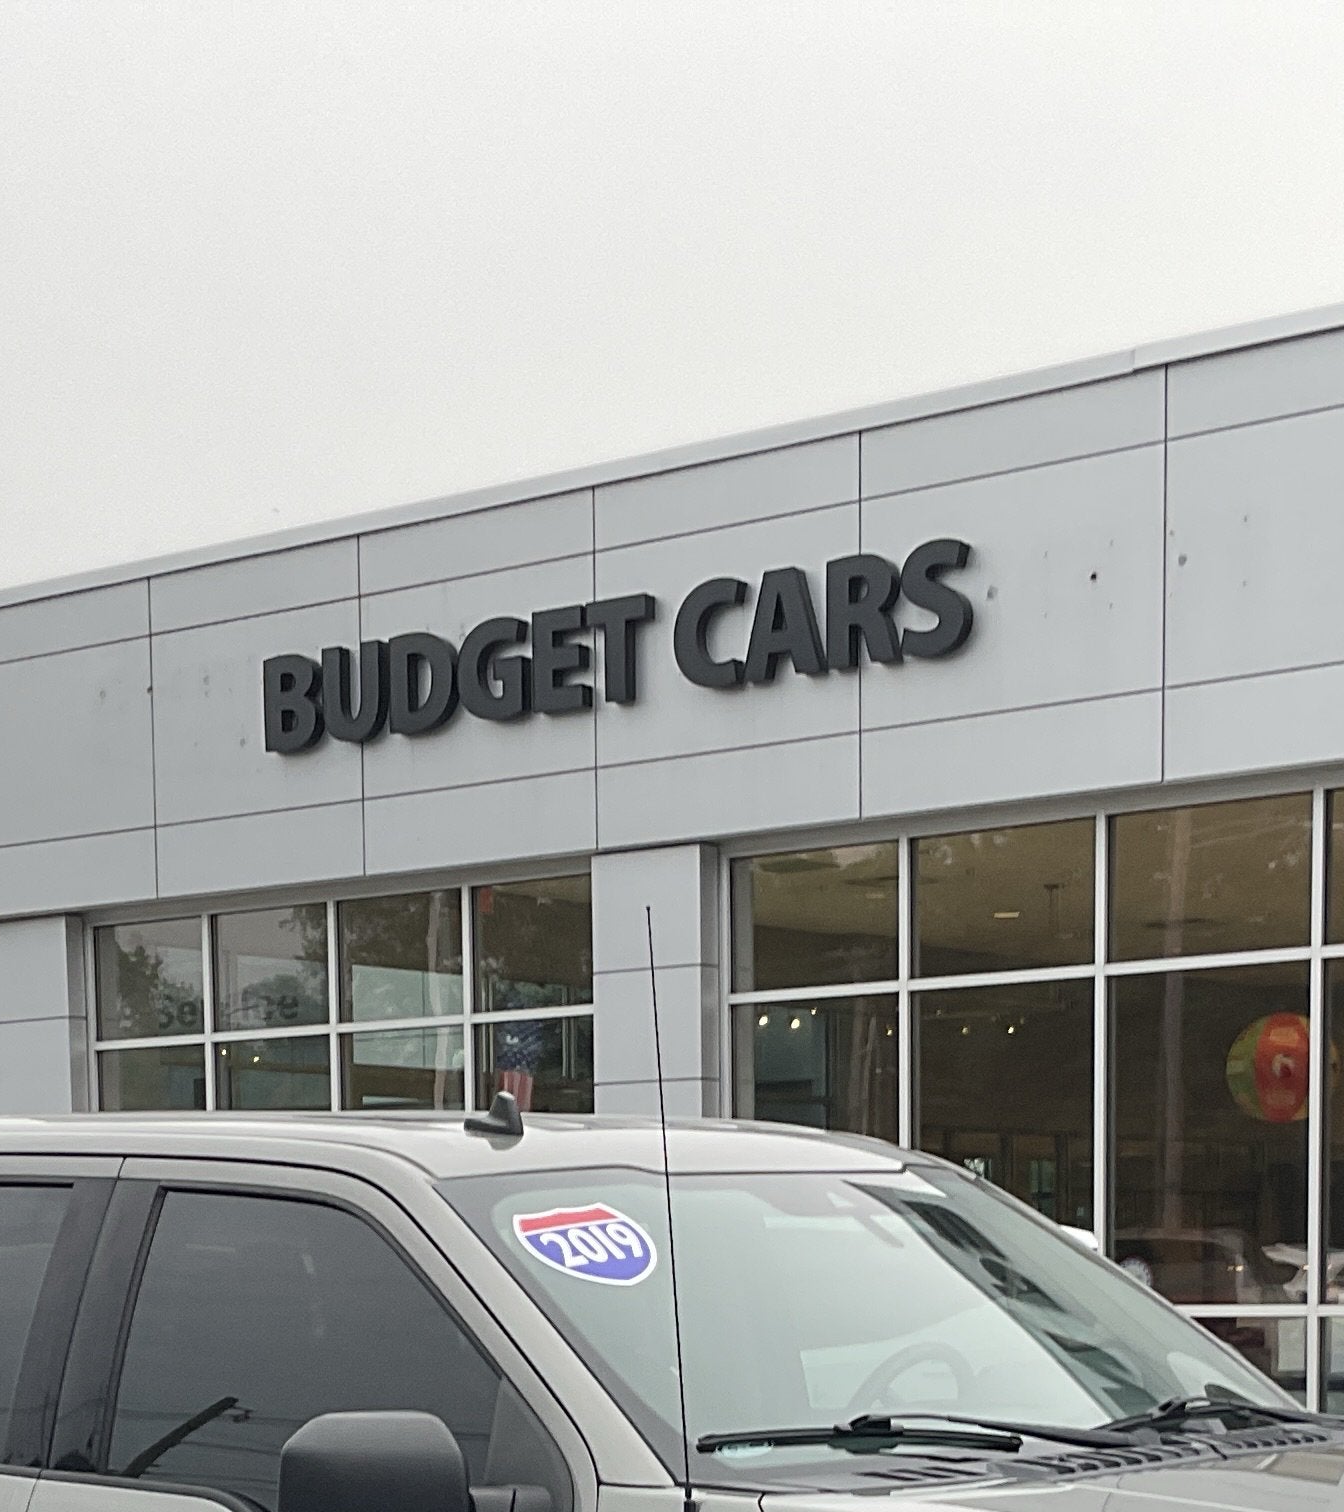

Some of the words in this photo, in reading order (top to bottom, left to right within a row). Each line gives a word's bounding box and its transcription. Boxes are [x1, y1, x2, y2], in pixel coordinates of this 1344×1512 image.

[263, 592, 656, 755] BUDGET
[673, 537, 975, 690] CARS
[539, 1220, 645, 1268] 2019
